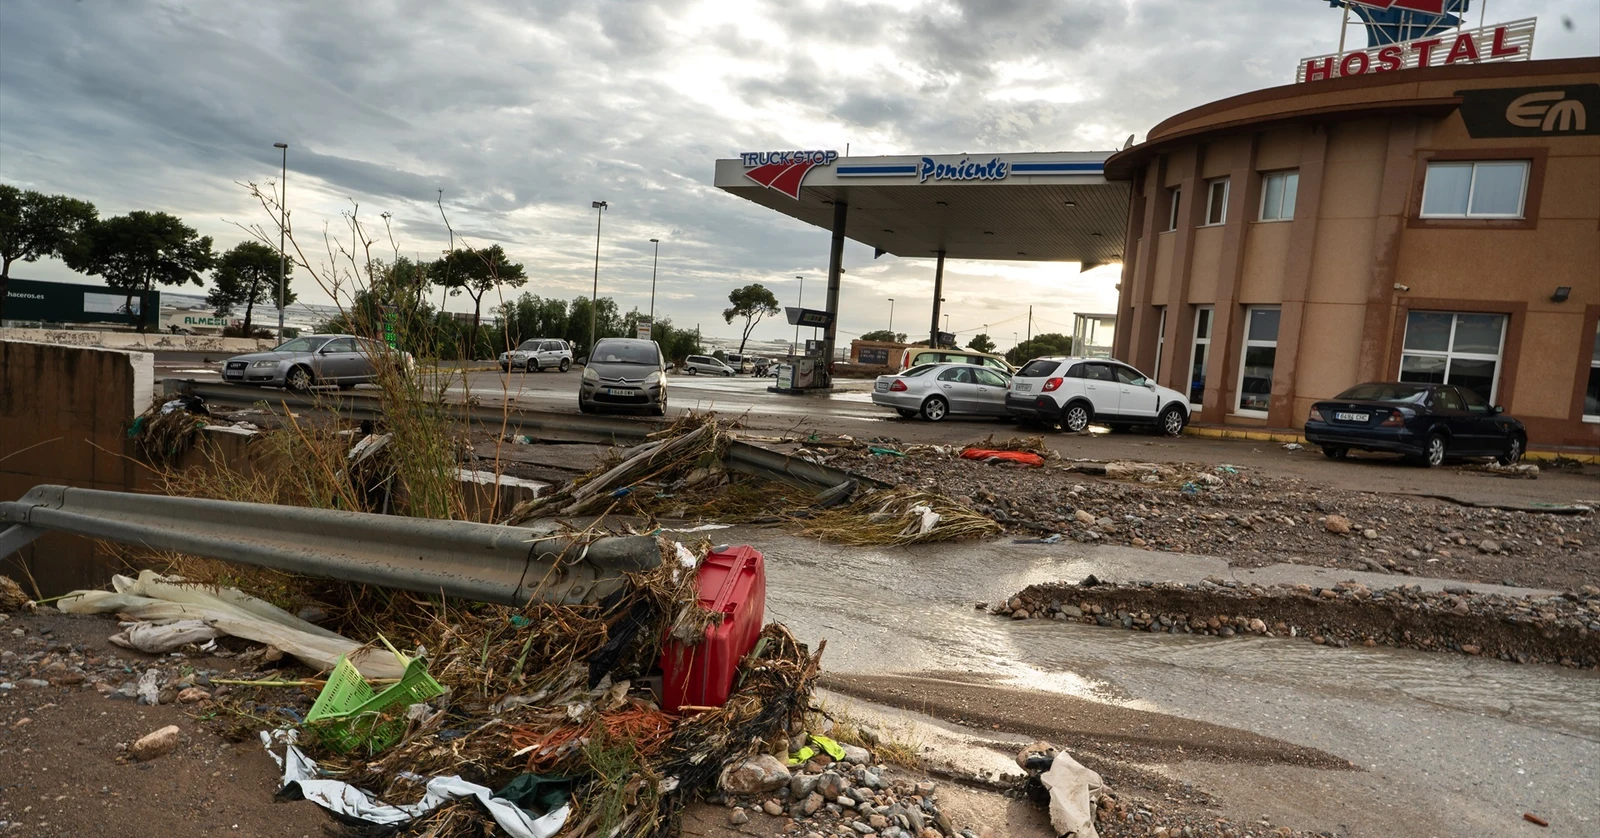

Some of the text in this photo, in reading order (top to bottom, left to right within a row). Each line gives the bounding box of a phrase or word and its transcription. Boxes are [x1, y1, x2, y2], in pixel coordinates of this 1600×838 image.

[1304, 27, 1521, 82] HOSTAL
[793, 150, 837, 164] STOP
[921, 156, 1007, 181] Poniente
[6, 291, 45, 299] haceros.es
